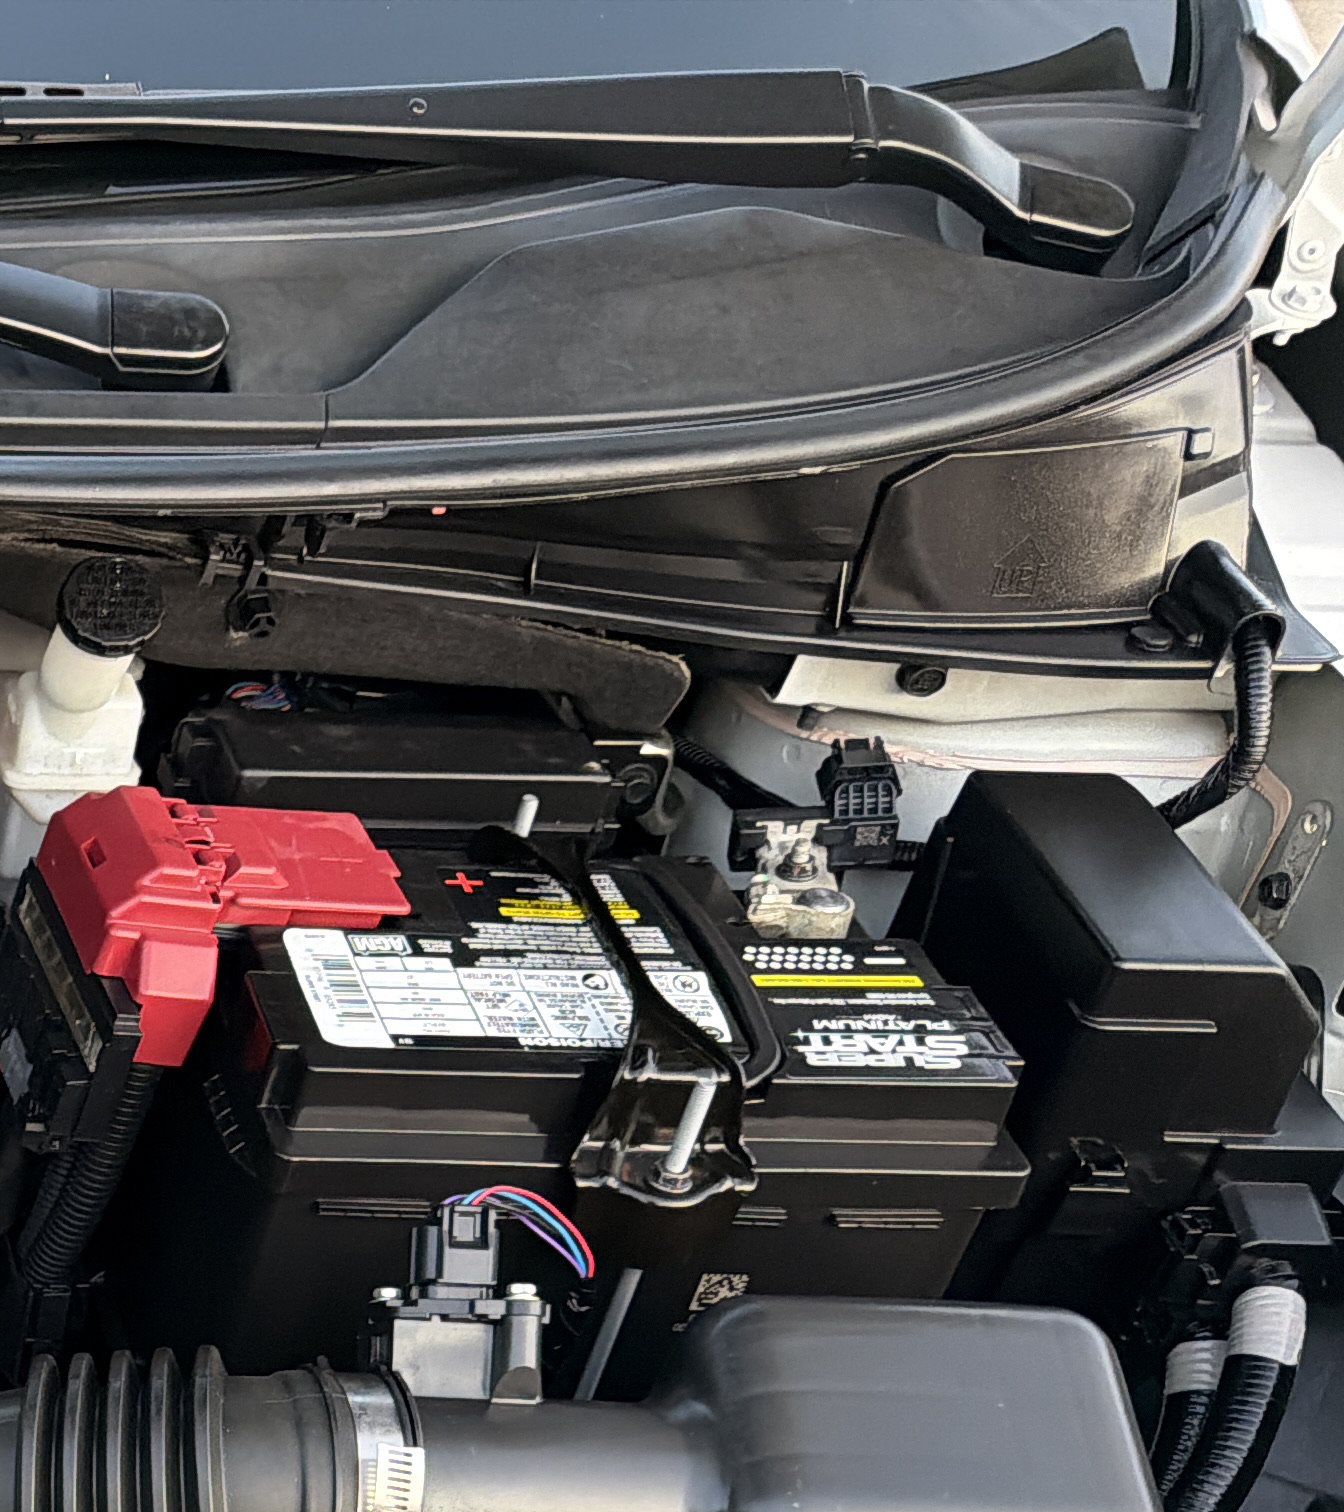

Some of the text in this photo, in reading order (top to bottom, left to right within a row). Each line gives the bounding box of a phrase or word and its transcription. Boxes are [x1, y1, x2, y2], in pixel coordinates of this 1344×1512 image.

[353, 936, 405, 951] AGM
[812, 1020, 950, 1030] PLATINUM
[793, 1034, 969, 1056] START
[805, 1052, 961, 1069] SUPER
